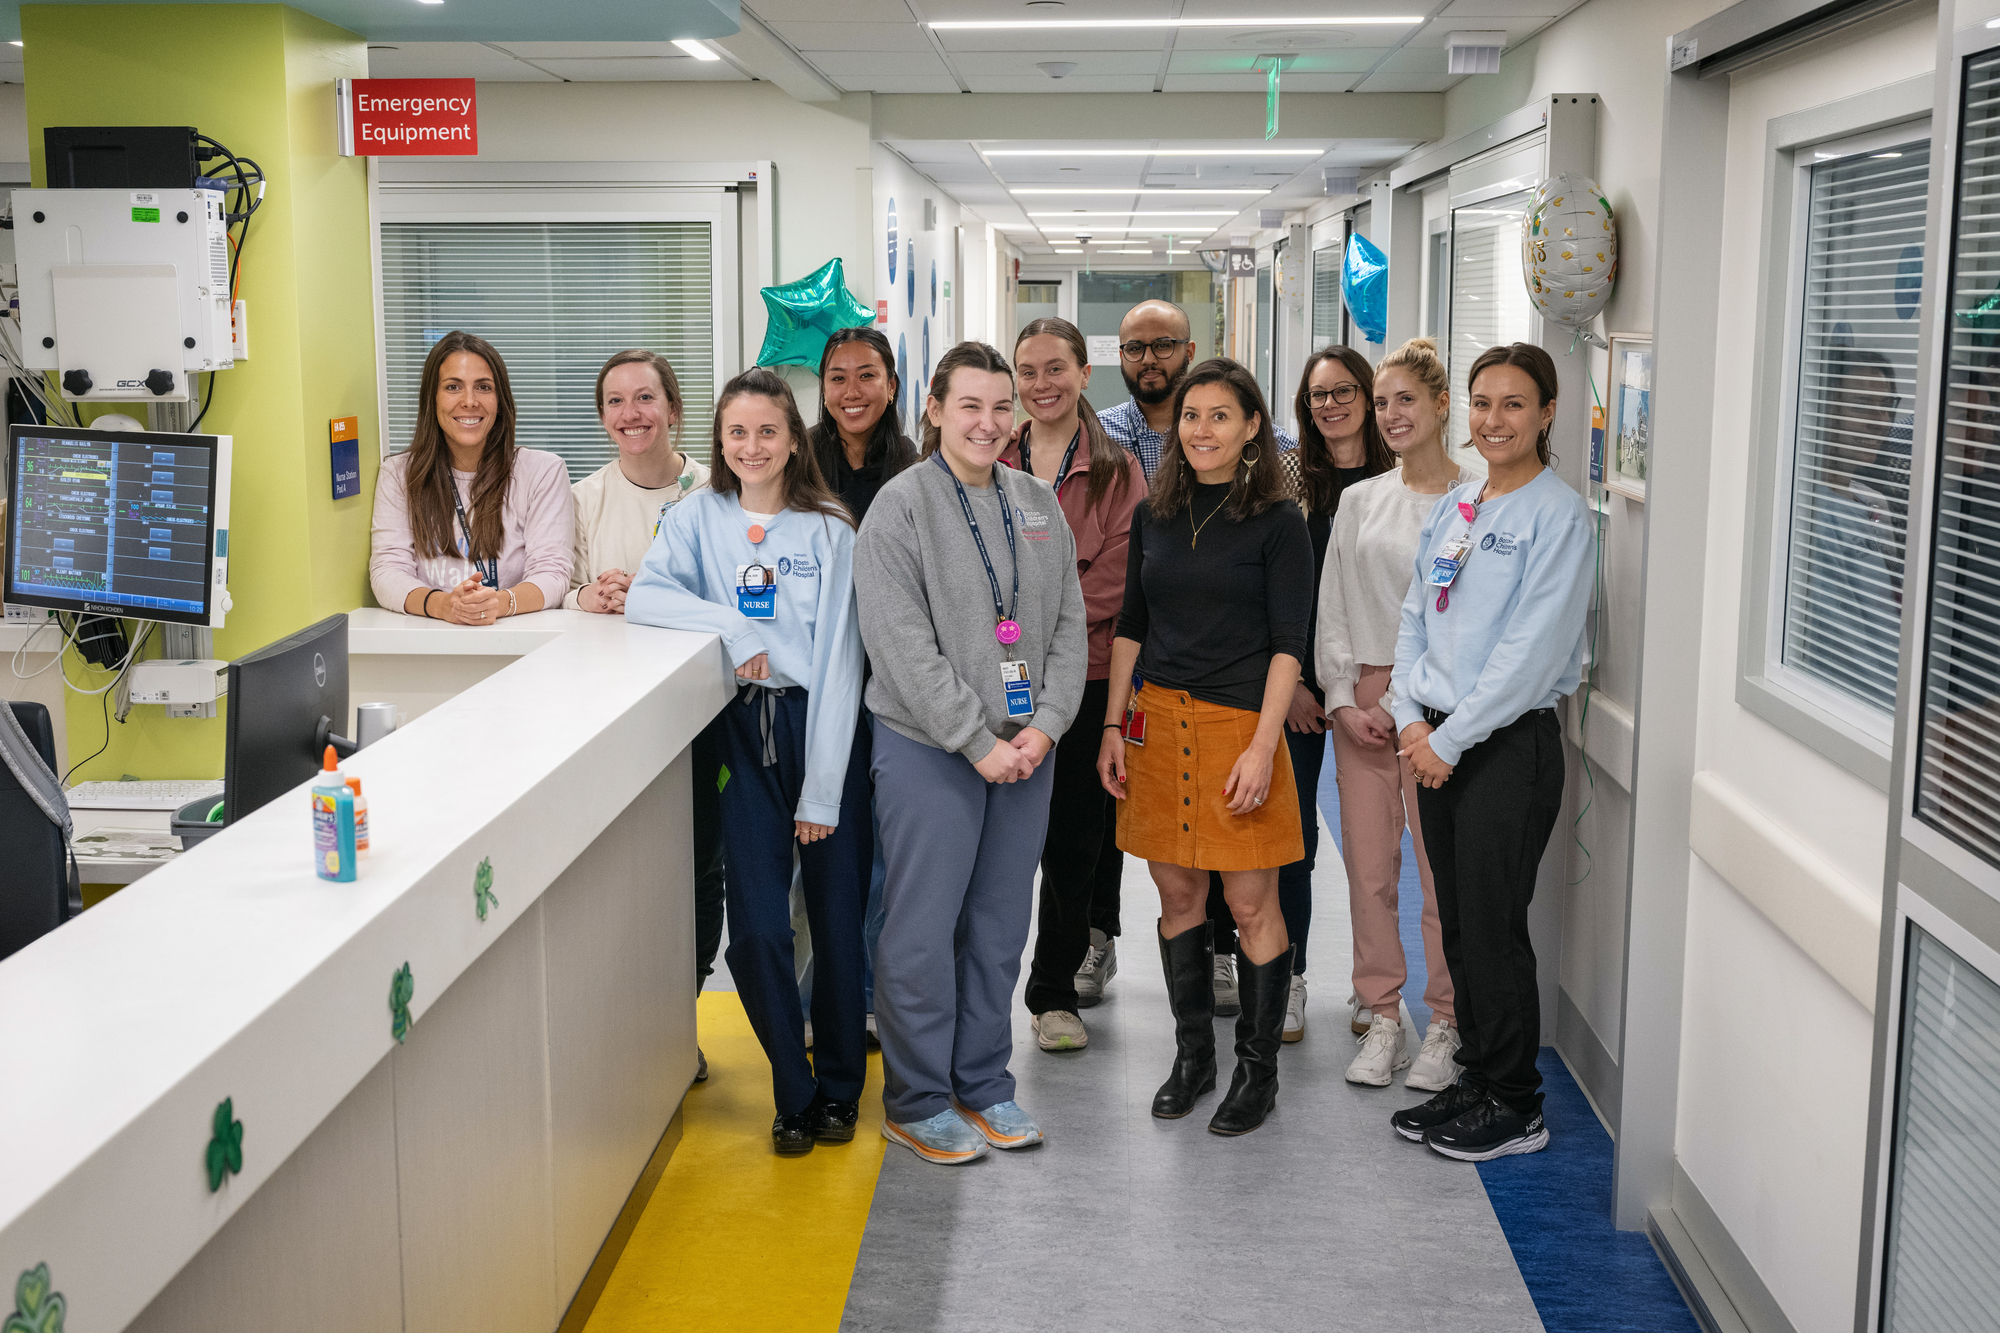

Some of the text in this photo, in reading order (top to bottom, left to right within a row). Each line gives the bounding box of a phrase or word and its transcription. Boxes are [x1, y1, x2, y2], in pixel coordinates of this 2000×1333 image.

[358, 94, 472, 116] Emergency
[362, 123, 471, 145] Equipment
[116, 380, 146, 388] GCX
[26, 460, 34, 472] 96
[336, 470, 357, 482] Nurse Station
[343, 483, 347, 492] A
[25, 497, 32, 508] 64
[793, 558, 810, 566] Boston
[793, 564, 818, 572] Children's
[21, 569, 30, 581] 101
[792, 570, 815, 579] Hospital
[743, 601, 770, 609] NURSE
[315, 664, 325, 676] DELL
[1010, 697, 1029, 706] NURSE
[1526, 1114, 1543, 1134] HOKA
